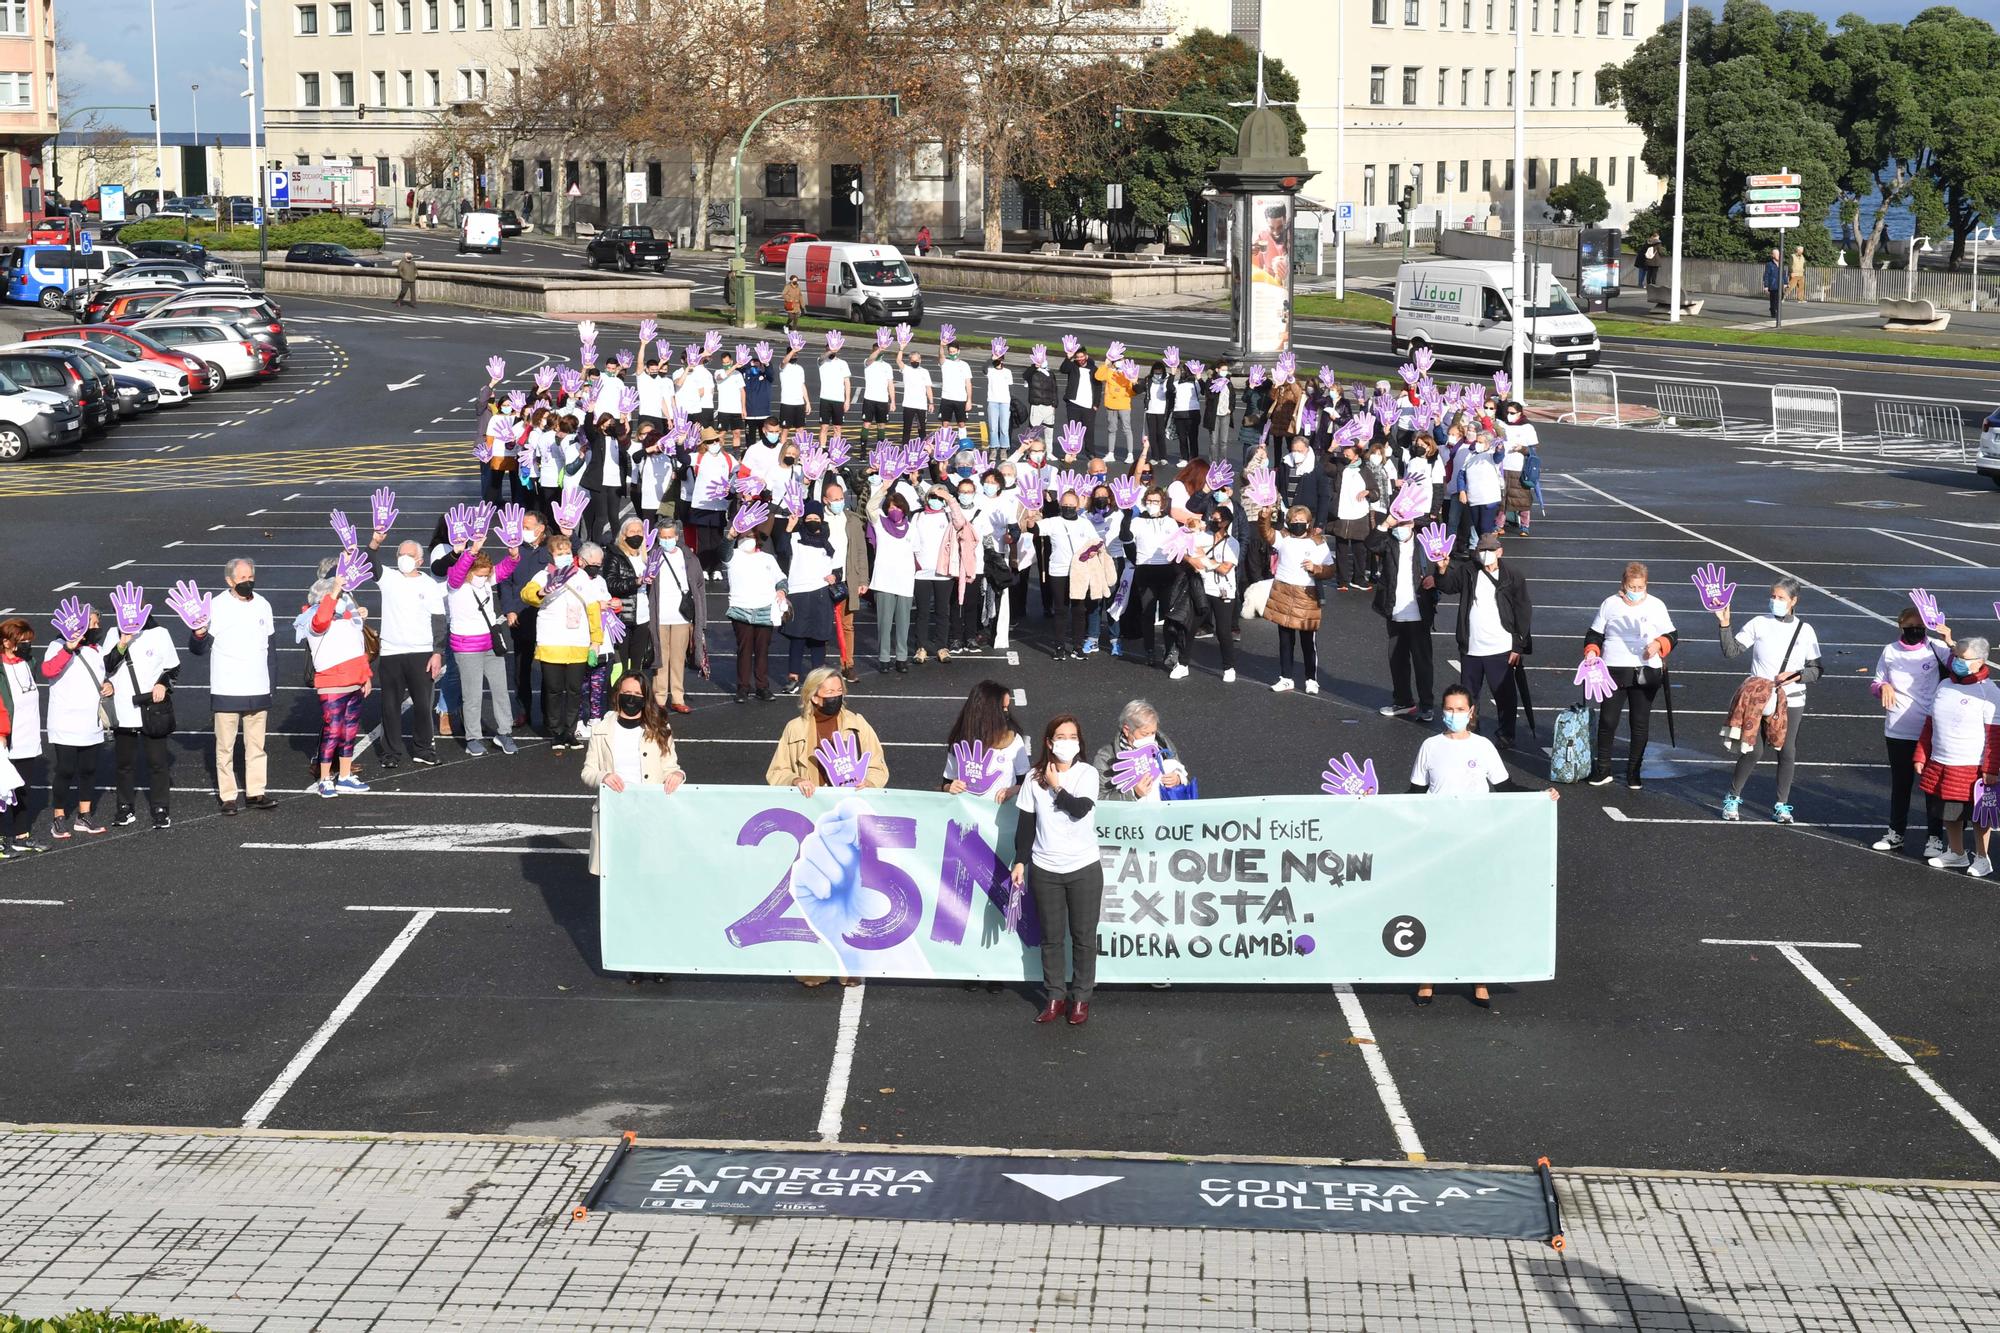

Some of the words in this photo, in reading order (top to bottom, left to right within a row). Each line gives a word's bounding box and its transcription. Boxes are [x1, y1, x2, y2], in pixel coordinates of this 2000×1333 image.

[271, 172, 288, 197] P
[1411, 270, 1463, 302] Vidual
[1705, 583, 1720, 591] 25N
[965, 760, 984, 770] 25N
[1096, 826, 1110, 838] SE
[1115, 826, 1144, 840] CRES
[1155, 824, 1193, 841] QUE
[1202, 817, 1261, 842] NON
[724, 808, 1041, 950] 25N
[1168, 847, 1268, 884] QUE
[1281, 849, 1373, 888] NON
[1099, 885, 1315, 926] EXISTA.
[1188, 935, 1213, 959] O
[659, 1164, 696, 1178] A
[716, 1166, 935, 1183] CORUÑA
[650, 1178, 720, 1195] EN
[737, 1181, 922, 1197] NEGRO
[1200, 1178, 1420, 1198] CONTRA
[1199, 1192, 1446, 1213] VIOLENC
